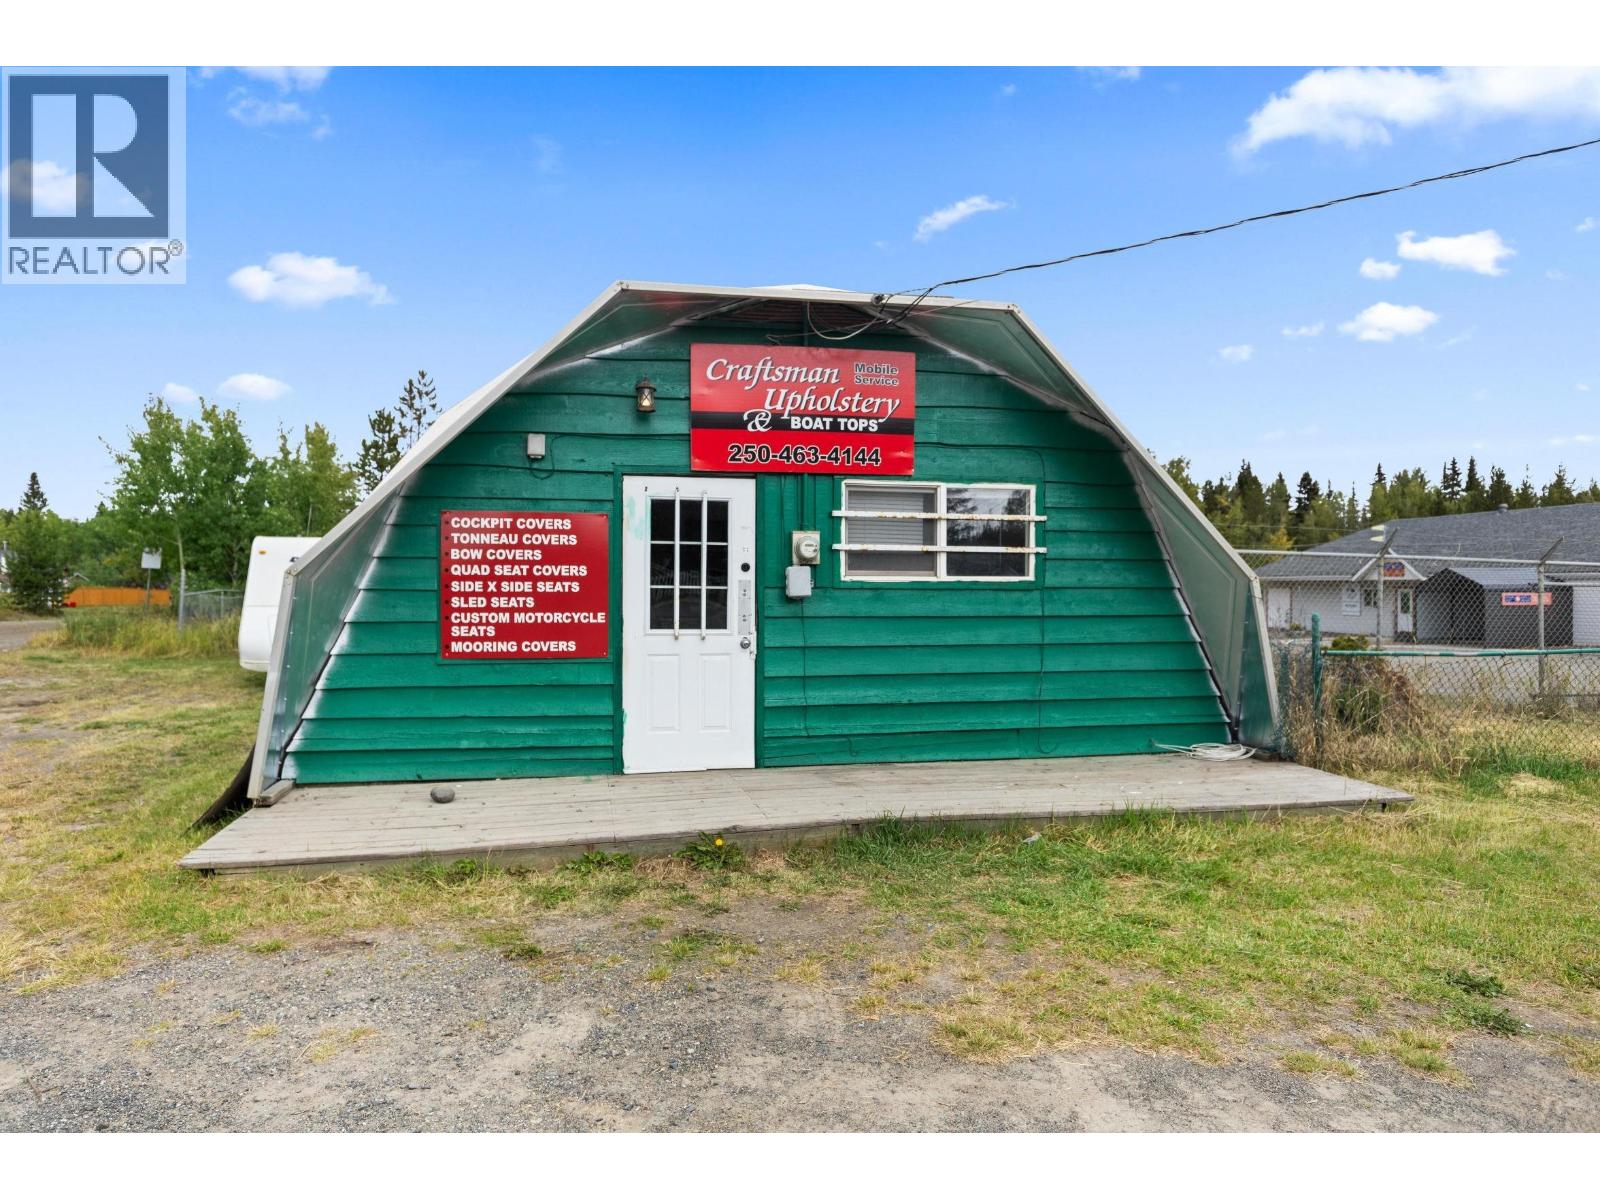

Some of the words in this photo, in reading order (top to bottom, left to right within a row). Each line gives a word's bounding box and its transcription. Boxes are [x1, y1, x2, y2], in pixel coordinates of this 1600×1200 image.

[706, 356, 840, 391] Craftsman
[854, 362, 899, 375] Mobile
[854, 374, 899, 387] Service
[764, 385, 901, 423] Upholstery
[743, 409, 773, 432] &
[790, 416, 834, 431] BOAT
[837, 417, 879, 432] TOPS
[728, 443, 881, 466] 250-463-4144
[451, 517, 513, 529] COCKPIT
[516, 518, 572, 530] COVERS
[451, 533, 518, 545] TONNEAU
[522, 534, 577, 545] COVERS
[451, 549, 483, 560] BOW
[486, 549, 542, 560] COVERS
[451, 565, 490, 576] QUAD
[494, 565, 529, 576] SEAT
[533, 565, 587, 576] COVERS
[451, 581, 483, 592] SIDE
[487, 581, 497, 592] X
[501, 581, 533, 592] SIDE
[536, 581, 580, 592] SEATS
[451, 597, 486, 608] SLED
[491, 597, 534, 608] SEATS
[451, 612, 510, 623] CUSTOM
[514, 612, 606, 623] MOTORCYCLE
[451, 626, 495, 637] SEATS
[451, 641, 517, 653] MOORING
[521, 640, 576, 652] COVERS
